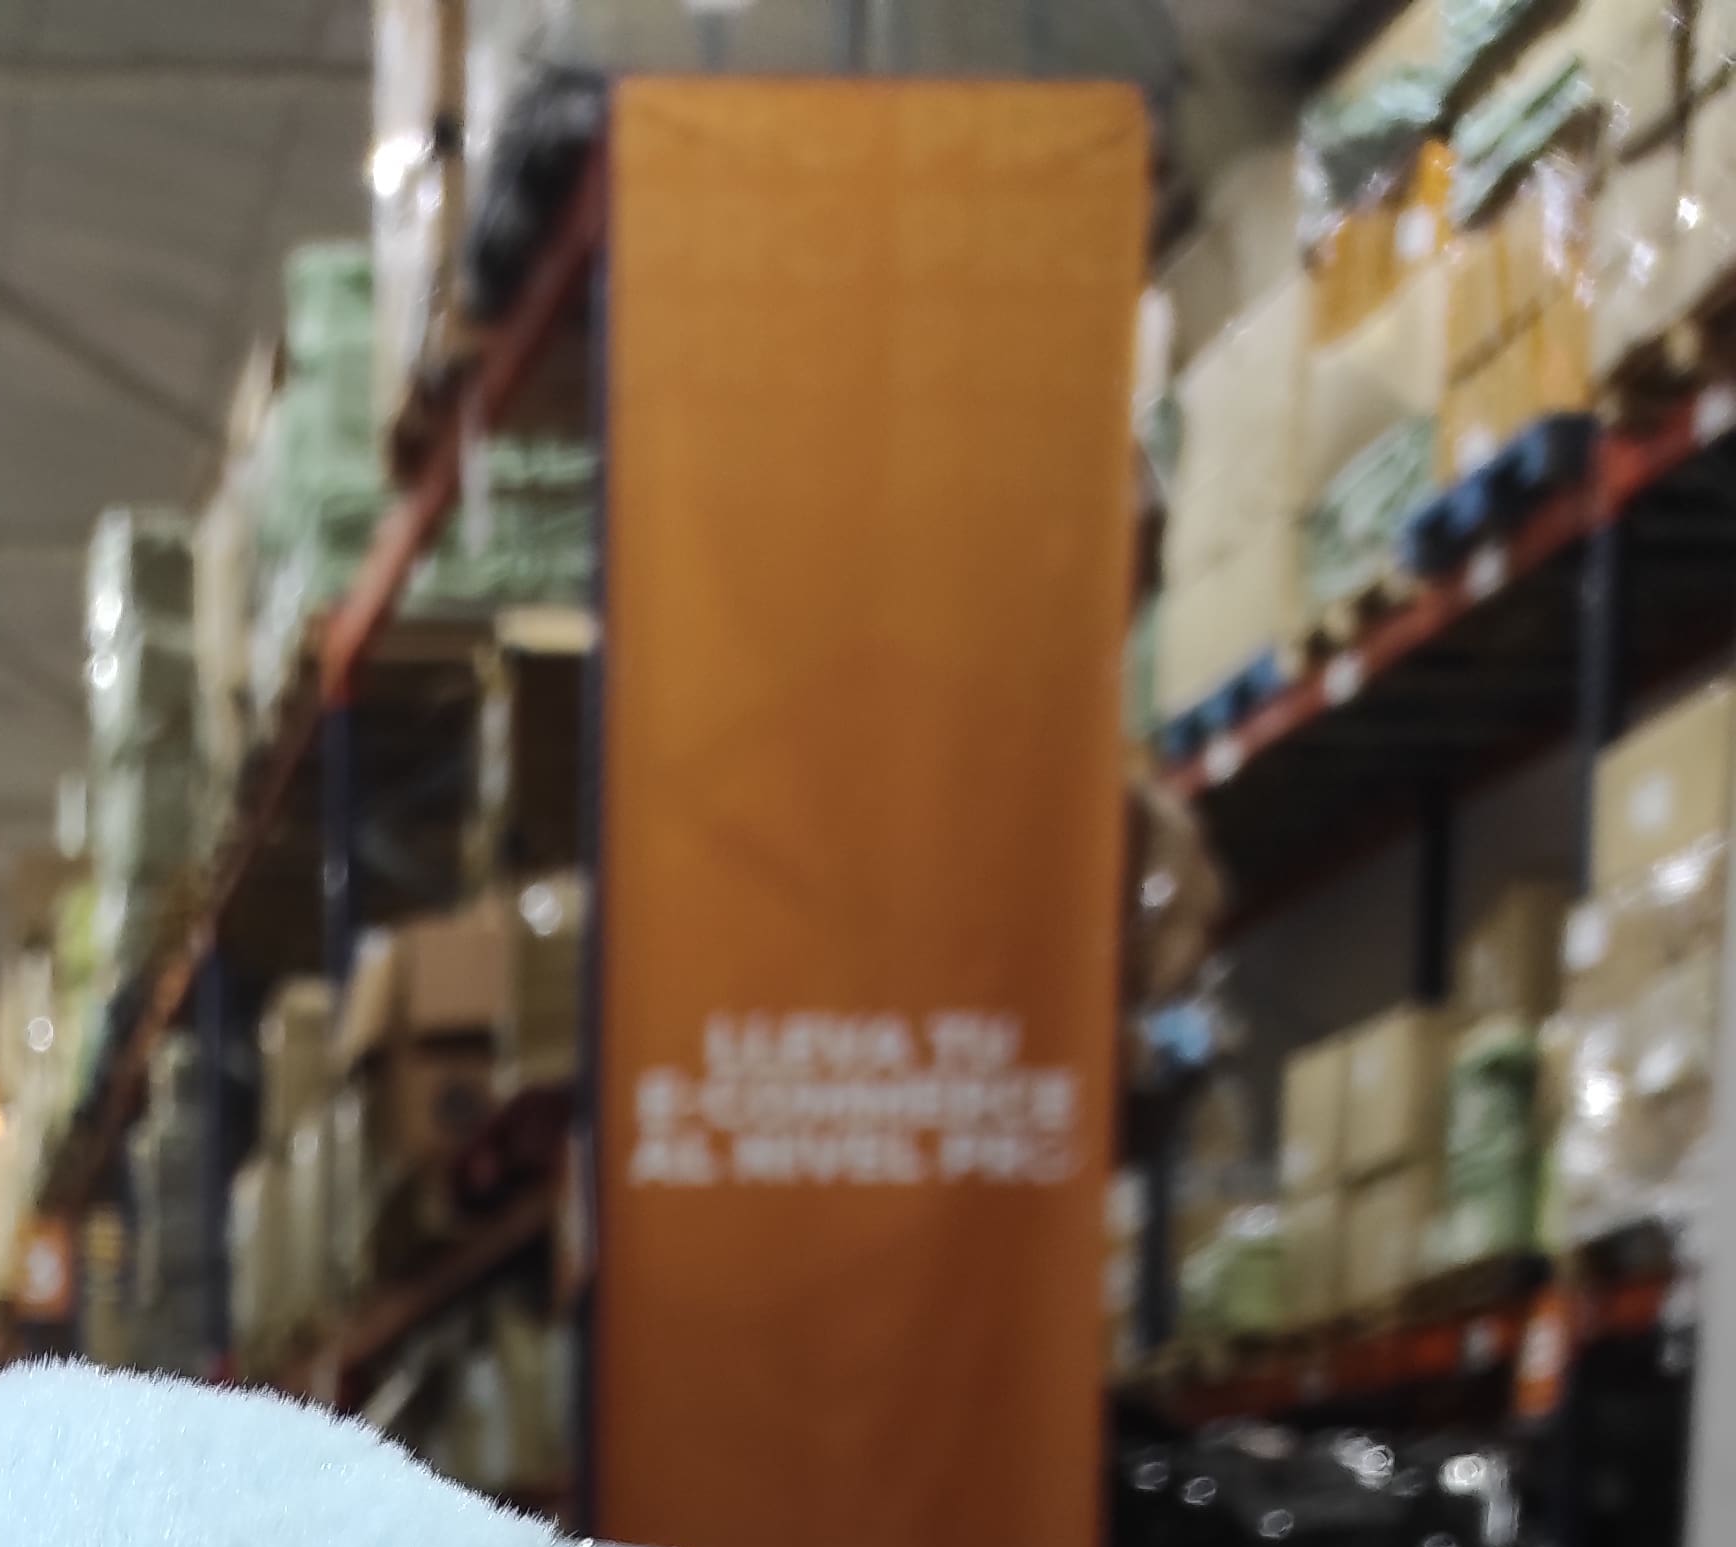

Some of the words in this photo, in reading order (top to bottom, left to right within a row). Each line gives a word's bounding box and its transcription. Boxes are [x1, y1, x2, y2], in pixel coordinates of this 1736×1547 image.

[704, 1012, 911, 1070] LLEVA
[930, 1012, 1022, 1070] TU
[634, 1069, 1076, 1130] E-COMMERCE
[631, 1128, 714, 1186] AL
[732, 1128, 920, 1186] NIVEL
